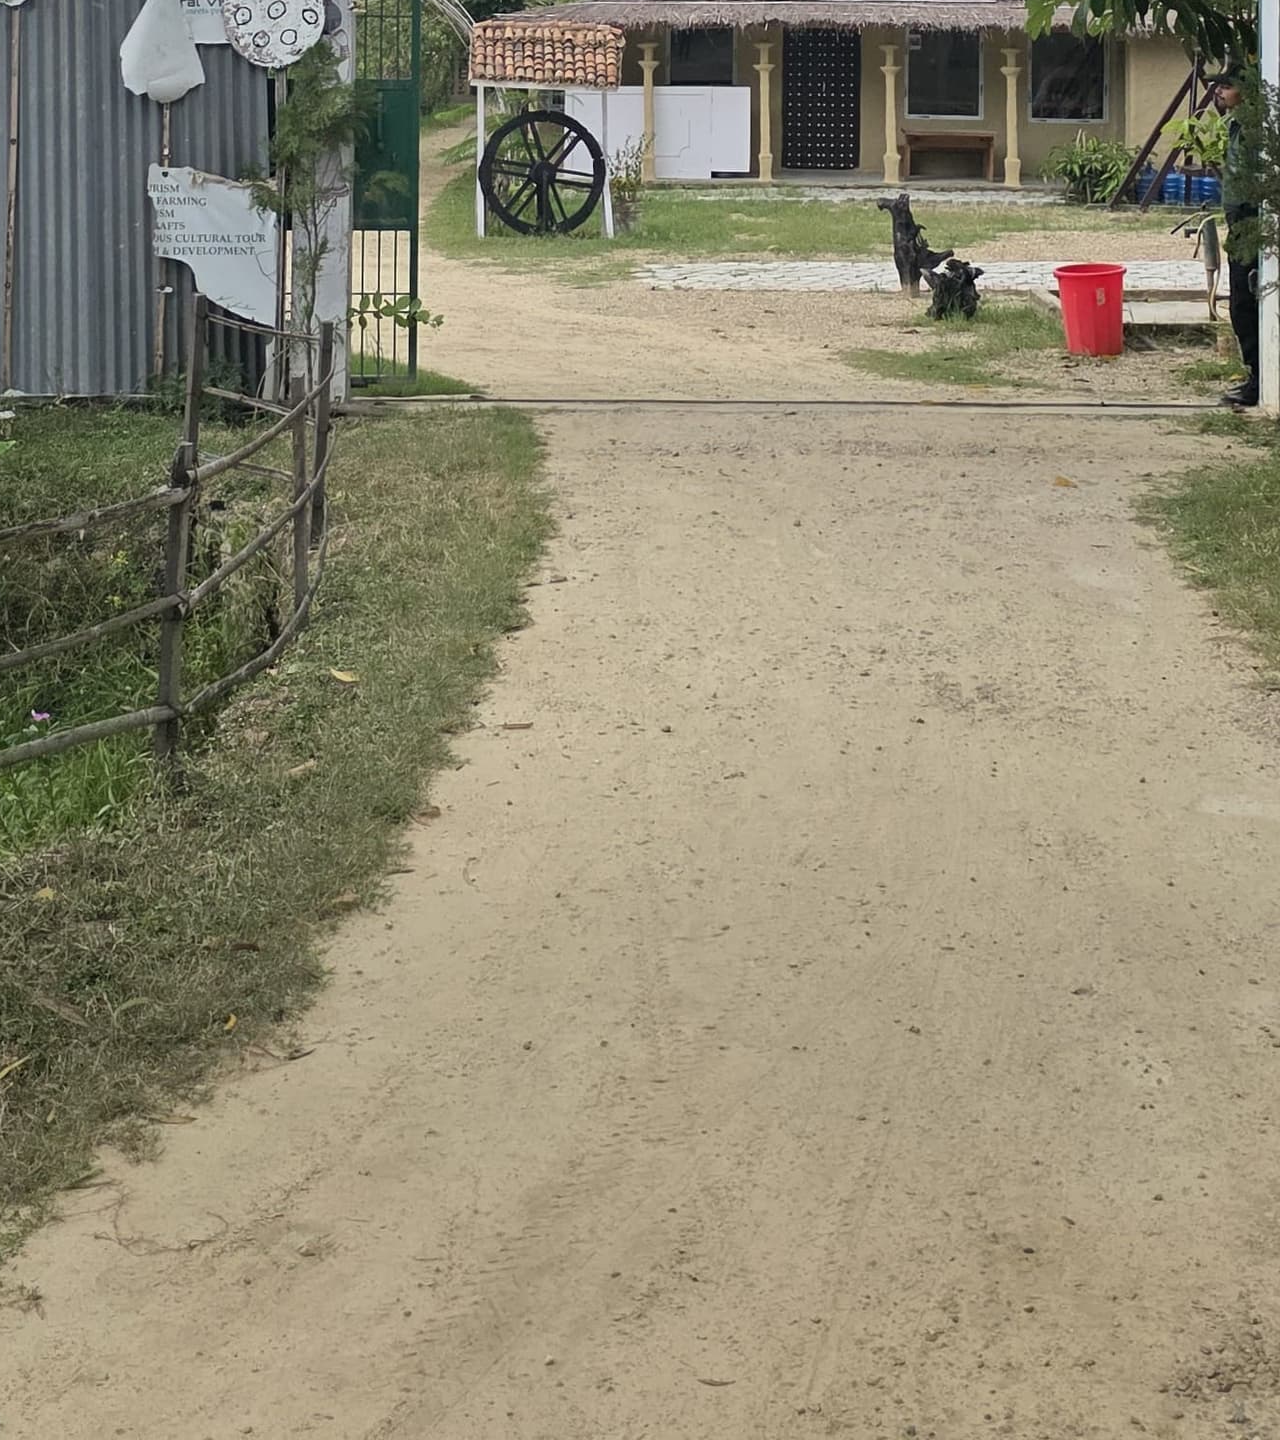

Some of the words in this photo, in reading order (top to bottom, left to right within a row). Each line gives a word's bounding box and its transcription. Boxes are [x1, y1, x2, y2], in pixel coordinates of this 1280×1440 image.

[156, 197, 207, 206] FARMING
[174, 233, 232, 243] CULTURAL
[235, 233, 266, 243] TOUR
[173, 246, 255, 256] DEVELOPMENT
